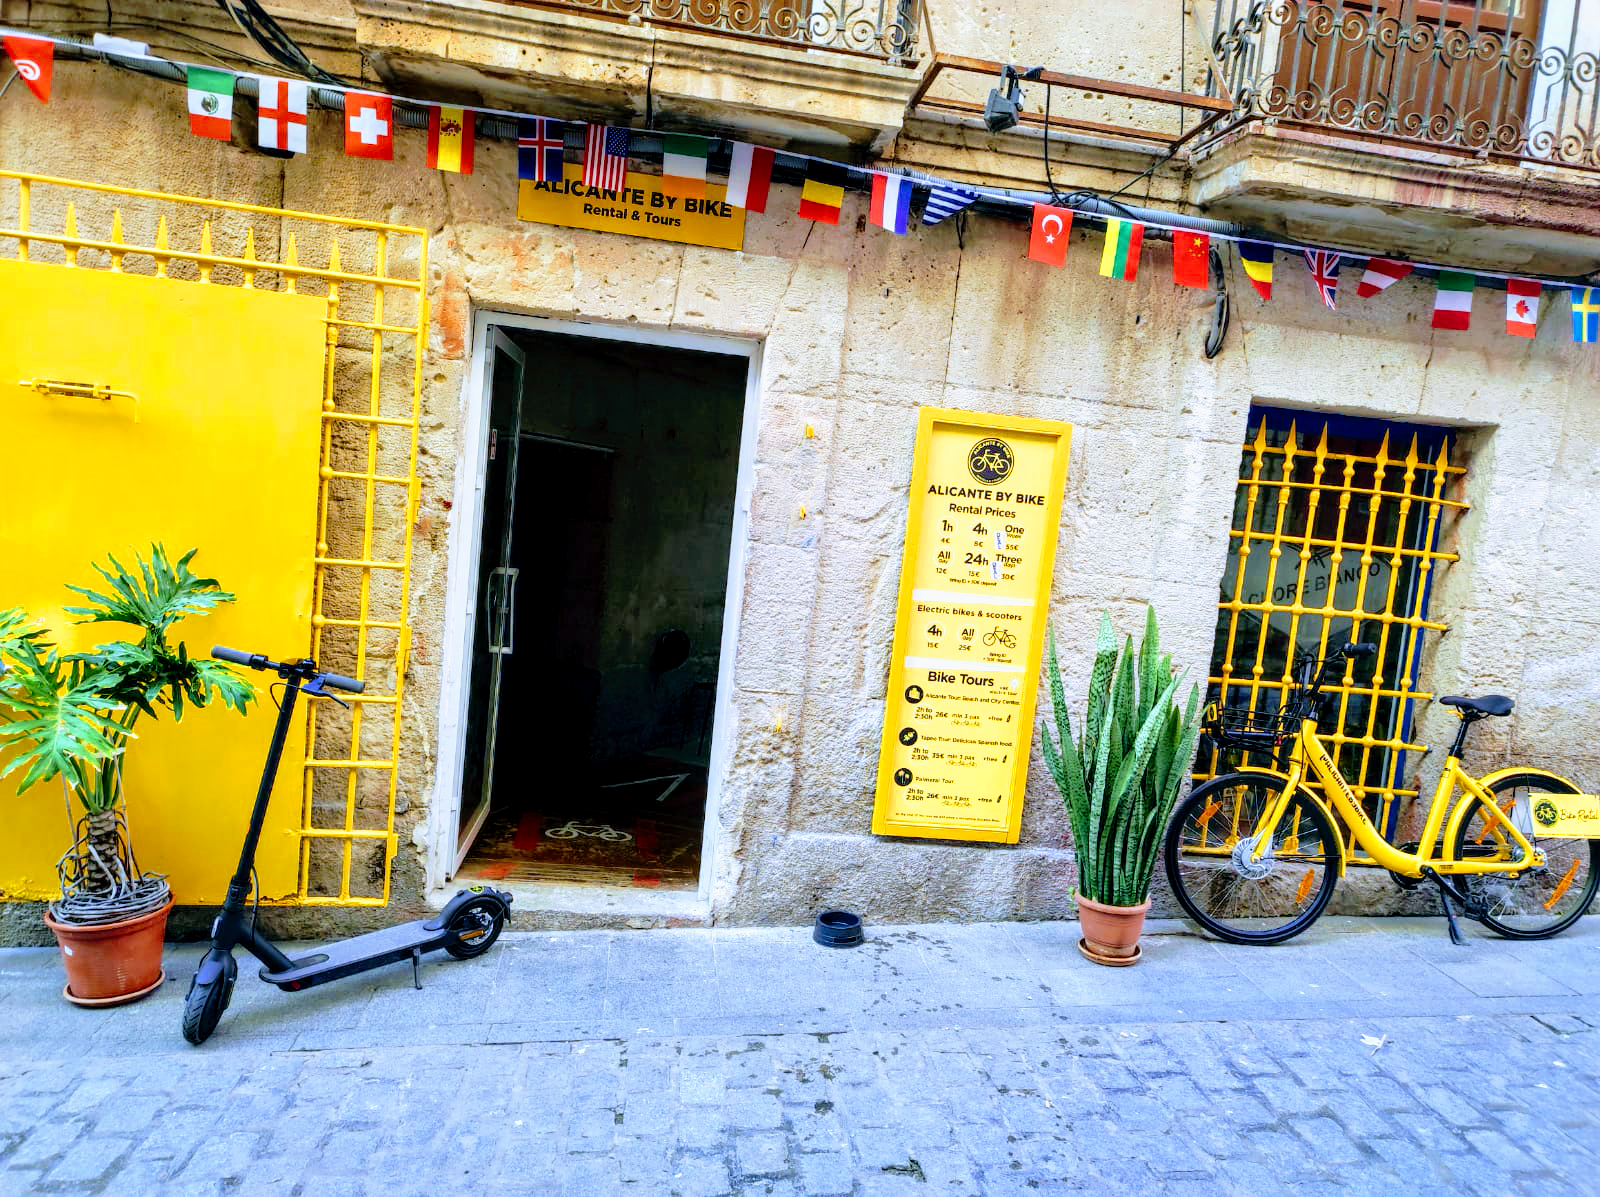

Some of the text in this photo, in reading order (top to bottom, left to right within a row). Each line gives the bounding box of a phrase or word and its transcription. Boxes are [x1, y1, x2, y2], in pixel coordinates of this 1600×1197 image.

[534, 179, 732, 218] ALICANTE BY BIKE
[583, 203, 681, 226] Rental & Tours
[928, 484, 1045, 506] ALICANTE BY BIKE
[949, 503, 1016, 519] Rental Prices
[942, 520, 953, 532] 1h
[972, 523, 987, 535] 4h
[1005, 524, 1024, 534] One
[937, 551, 951, 559] All
[964, 553, 988, 566] 24h
[996, 554, 1022, 564] Three
[918, 605, 950, 614] Electric
[952, 608, 974, 617] bikes
[985, 611, 1022, 621] scooters
[928, 624, 942, 637] 4h
[928, 671, 995, 687] Bike Tours
